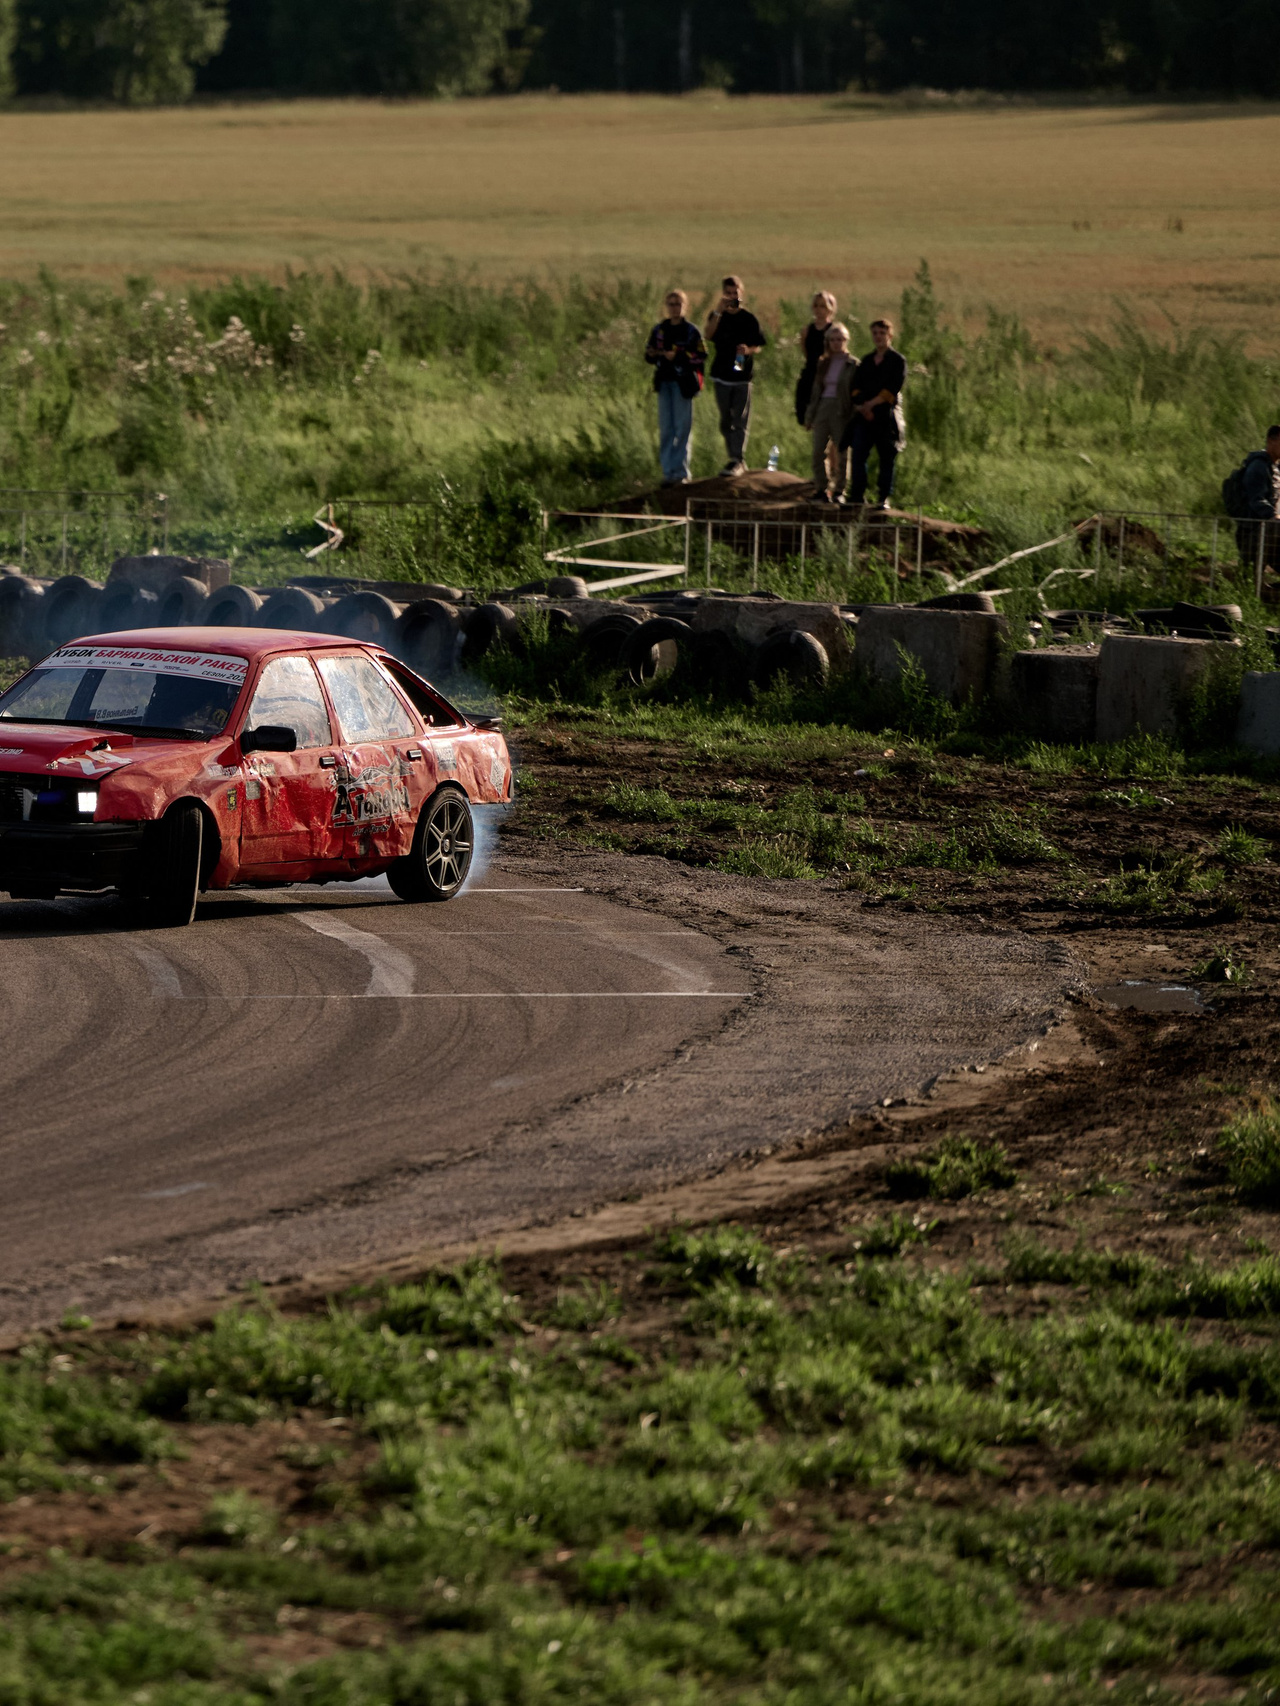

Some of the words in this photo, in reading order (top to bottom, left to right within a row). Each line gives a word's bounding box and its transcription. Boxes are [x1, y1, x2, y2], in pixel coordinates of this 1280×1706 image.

[52, 649, 97, 658] КУБОК
[94, 649, 202, 665] БАРНАУЛЬСКОЙ
[201, 670, 227, 678] СЕЗОН
[226, 673, 246, 681] 202
